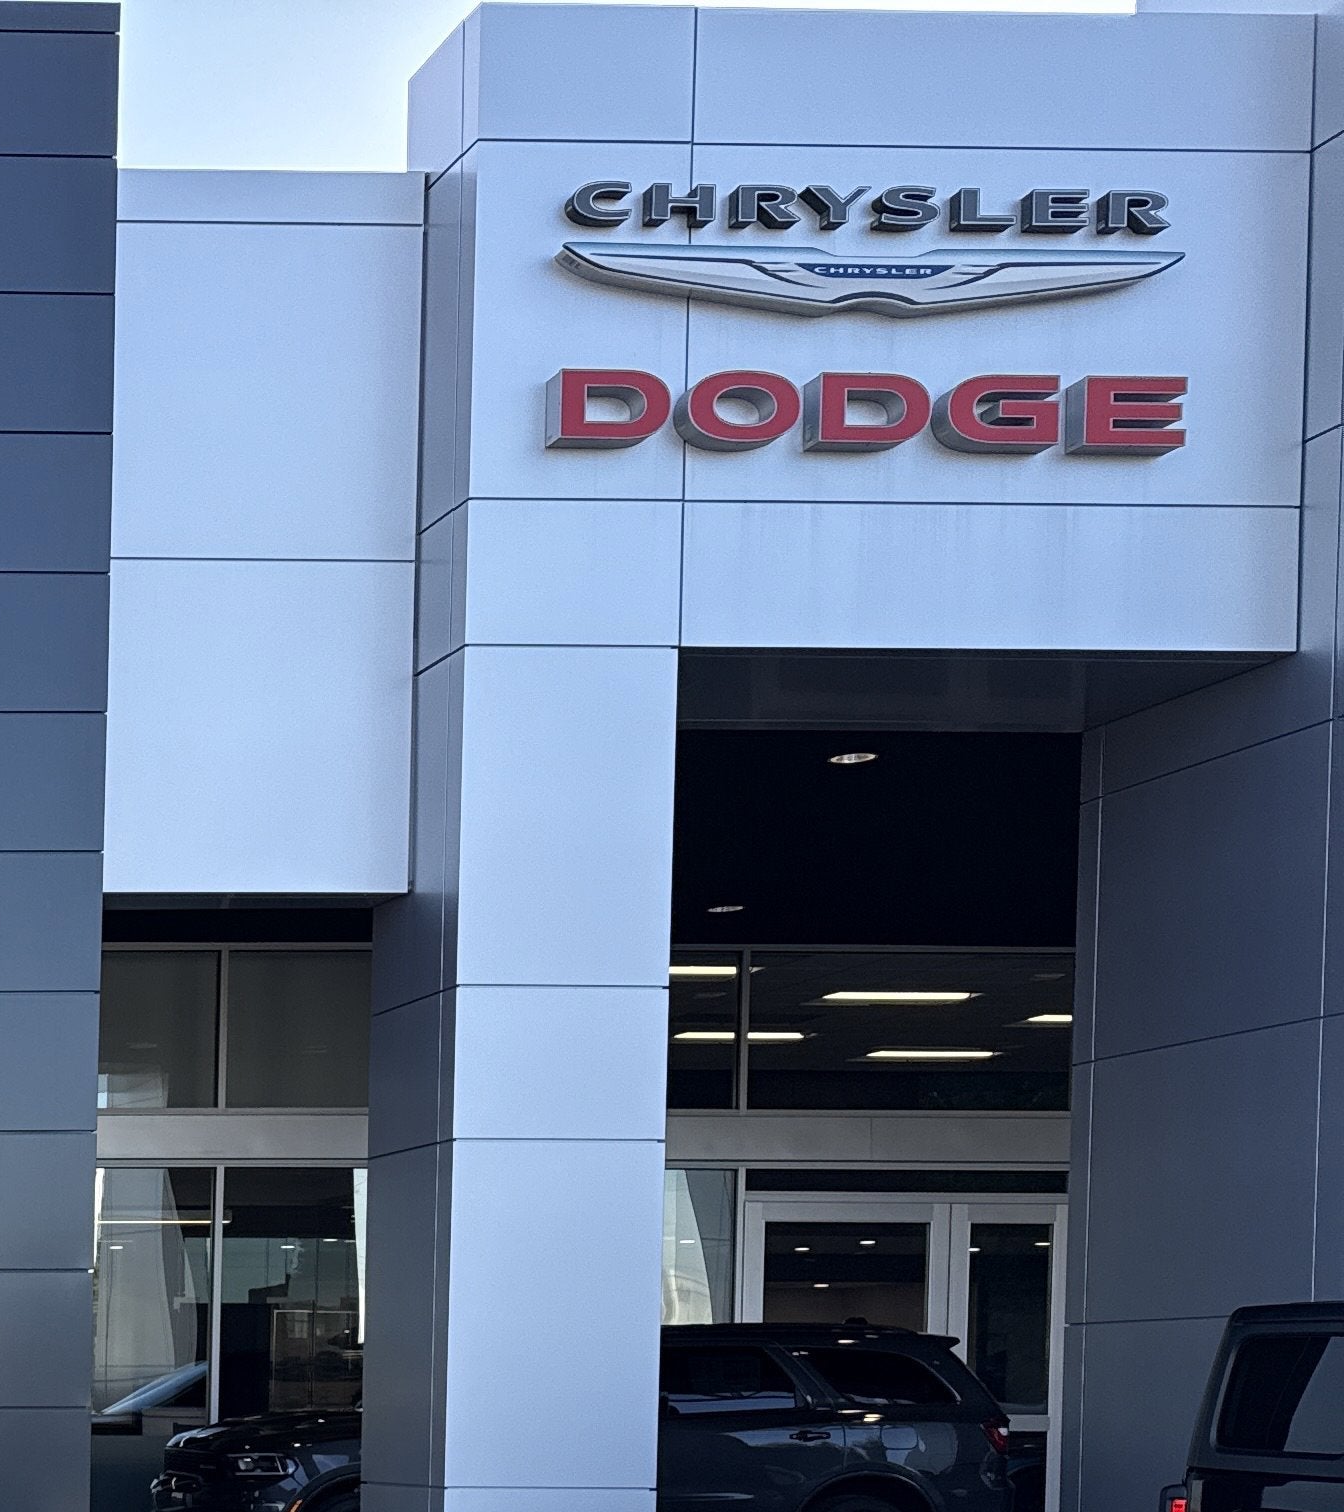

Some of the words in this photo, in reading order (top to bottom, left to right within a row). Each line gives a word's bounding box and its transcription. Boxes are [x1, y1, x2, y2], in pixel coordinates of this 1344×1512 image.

[564, 180, 1172, 236] CHRYSLER
[814, 266, 933, 276] CHRYSLER
[545, 367, 1189, 456] DODGE
